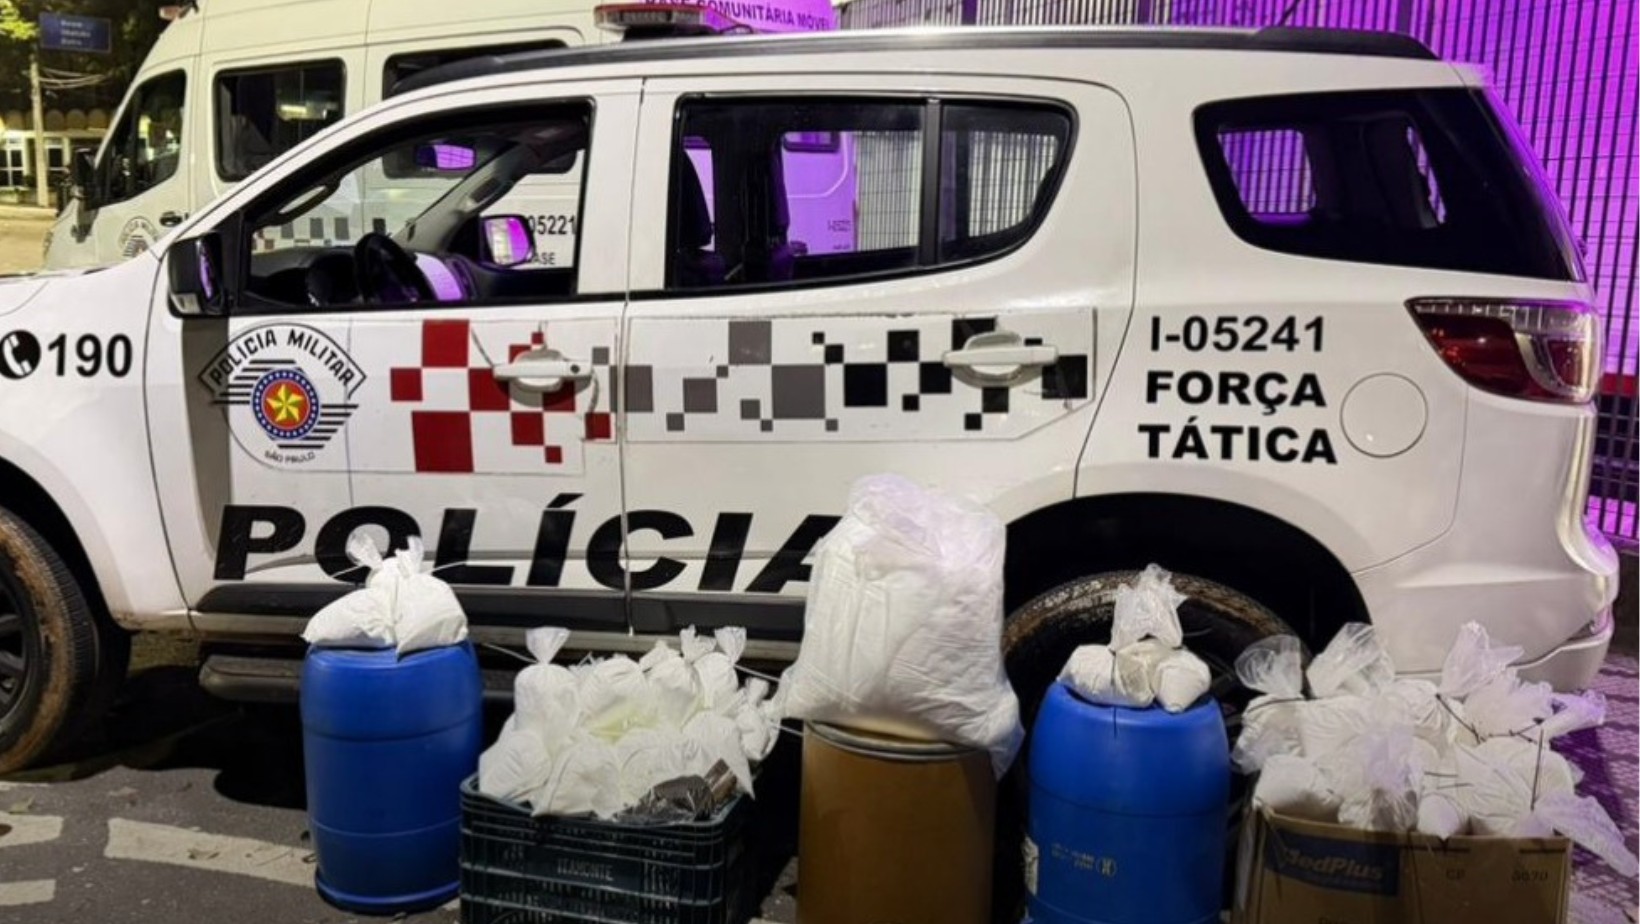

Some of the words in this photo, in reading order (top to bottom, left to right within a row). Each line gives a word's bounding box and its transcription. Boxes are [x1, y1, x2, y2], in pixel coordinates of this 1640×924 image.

[48, 333, 132, 377] 190
[1150, 316, 1324, 351] I-05241
[287, 329, 355, 386] MILITAR
[1146, 370, 1327, 416] FORÇA
[1137, 416, 1338, 465] TÁTICA
